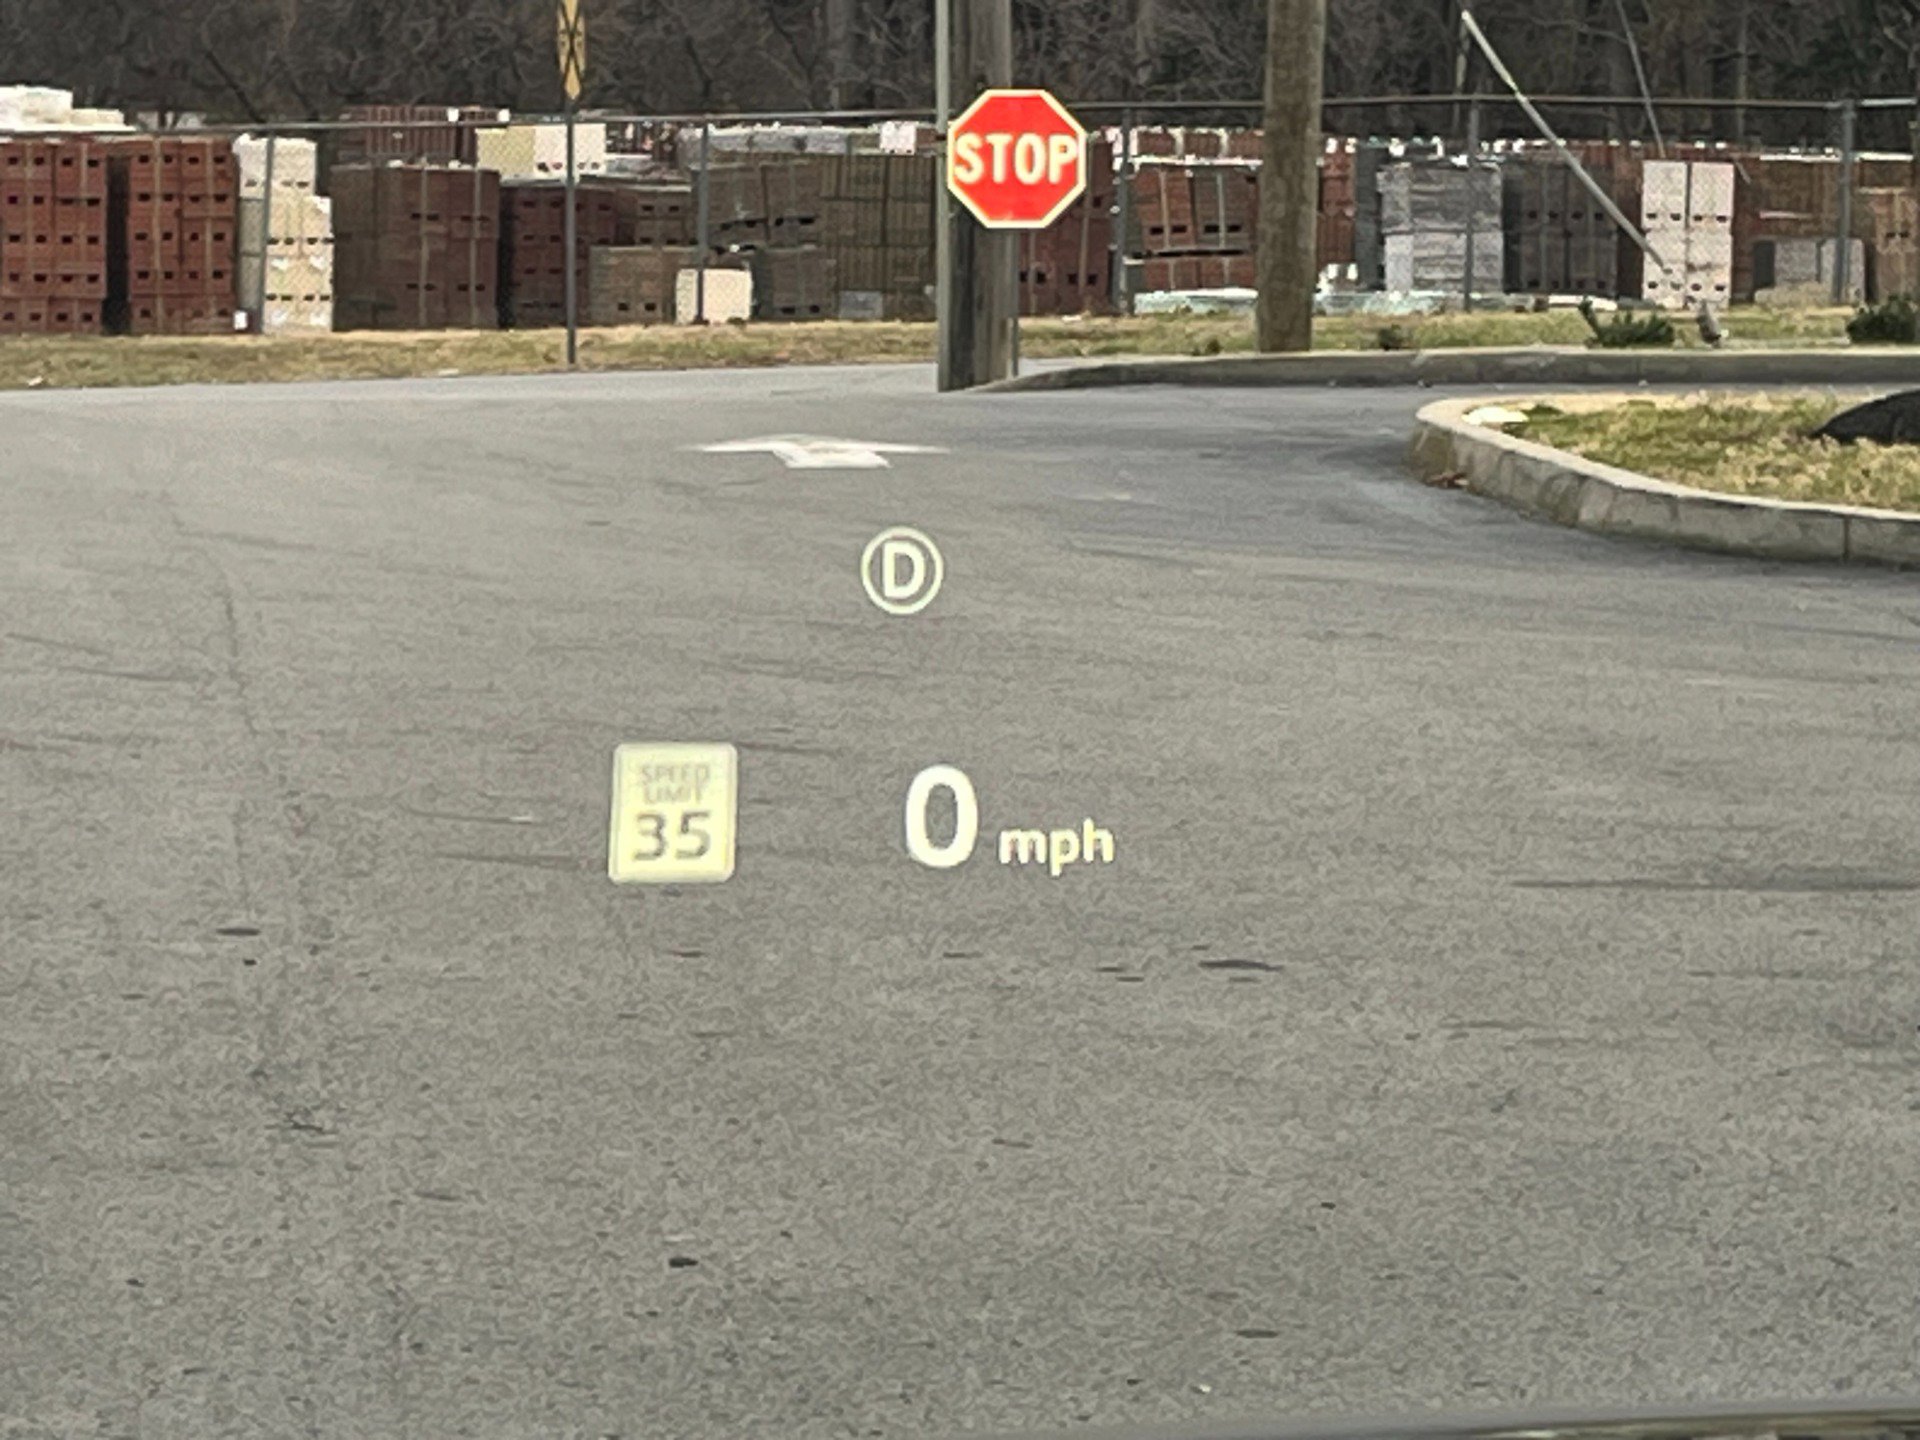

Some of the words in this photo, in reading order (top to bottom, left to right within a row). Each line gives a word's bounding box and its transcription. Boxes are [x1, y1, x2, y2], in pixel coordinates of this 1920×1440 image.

[954, 132, 1078, 184] STOP
[882, 541, 925, 598] D
[633, 811, 711, 860] 35
[906, 765, 978, 868] 0
[999, 817, 1114, 876] mph
